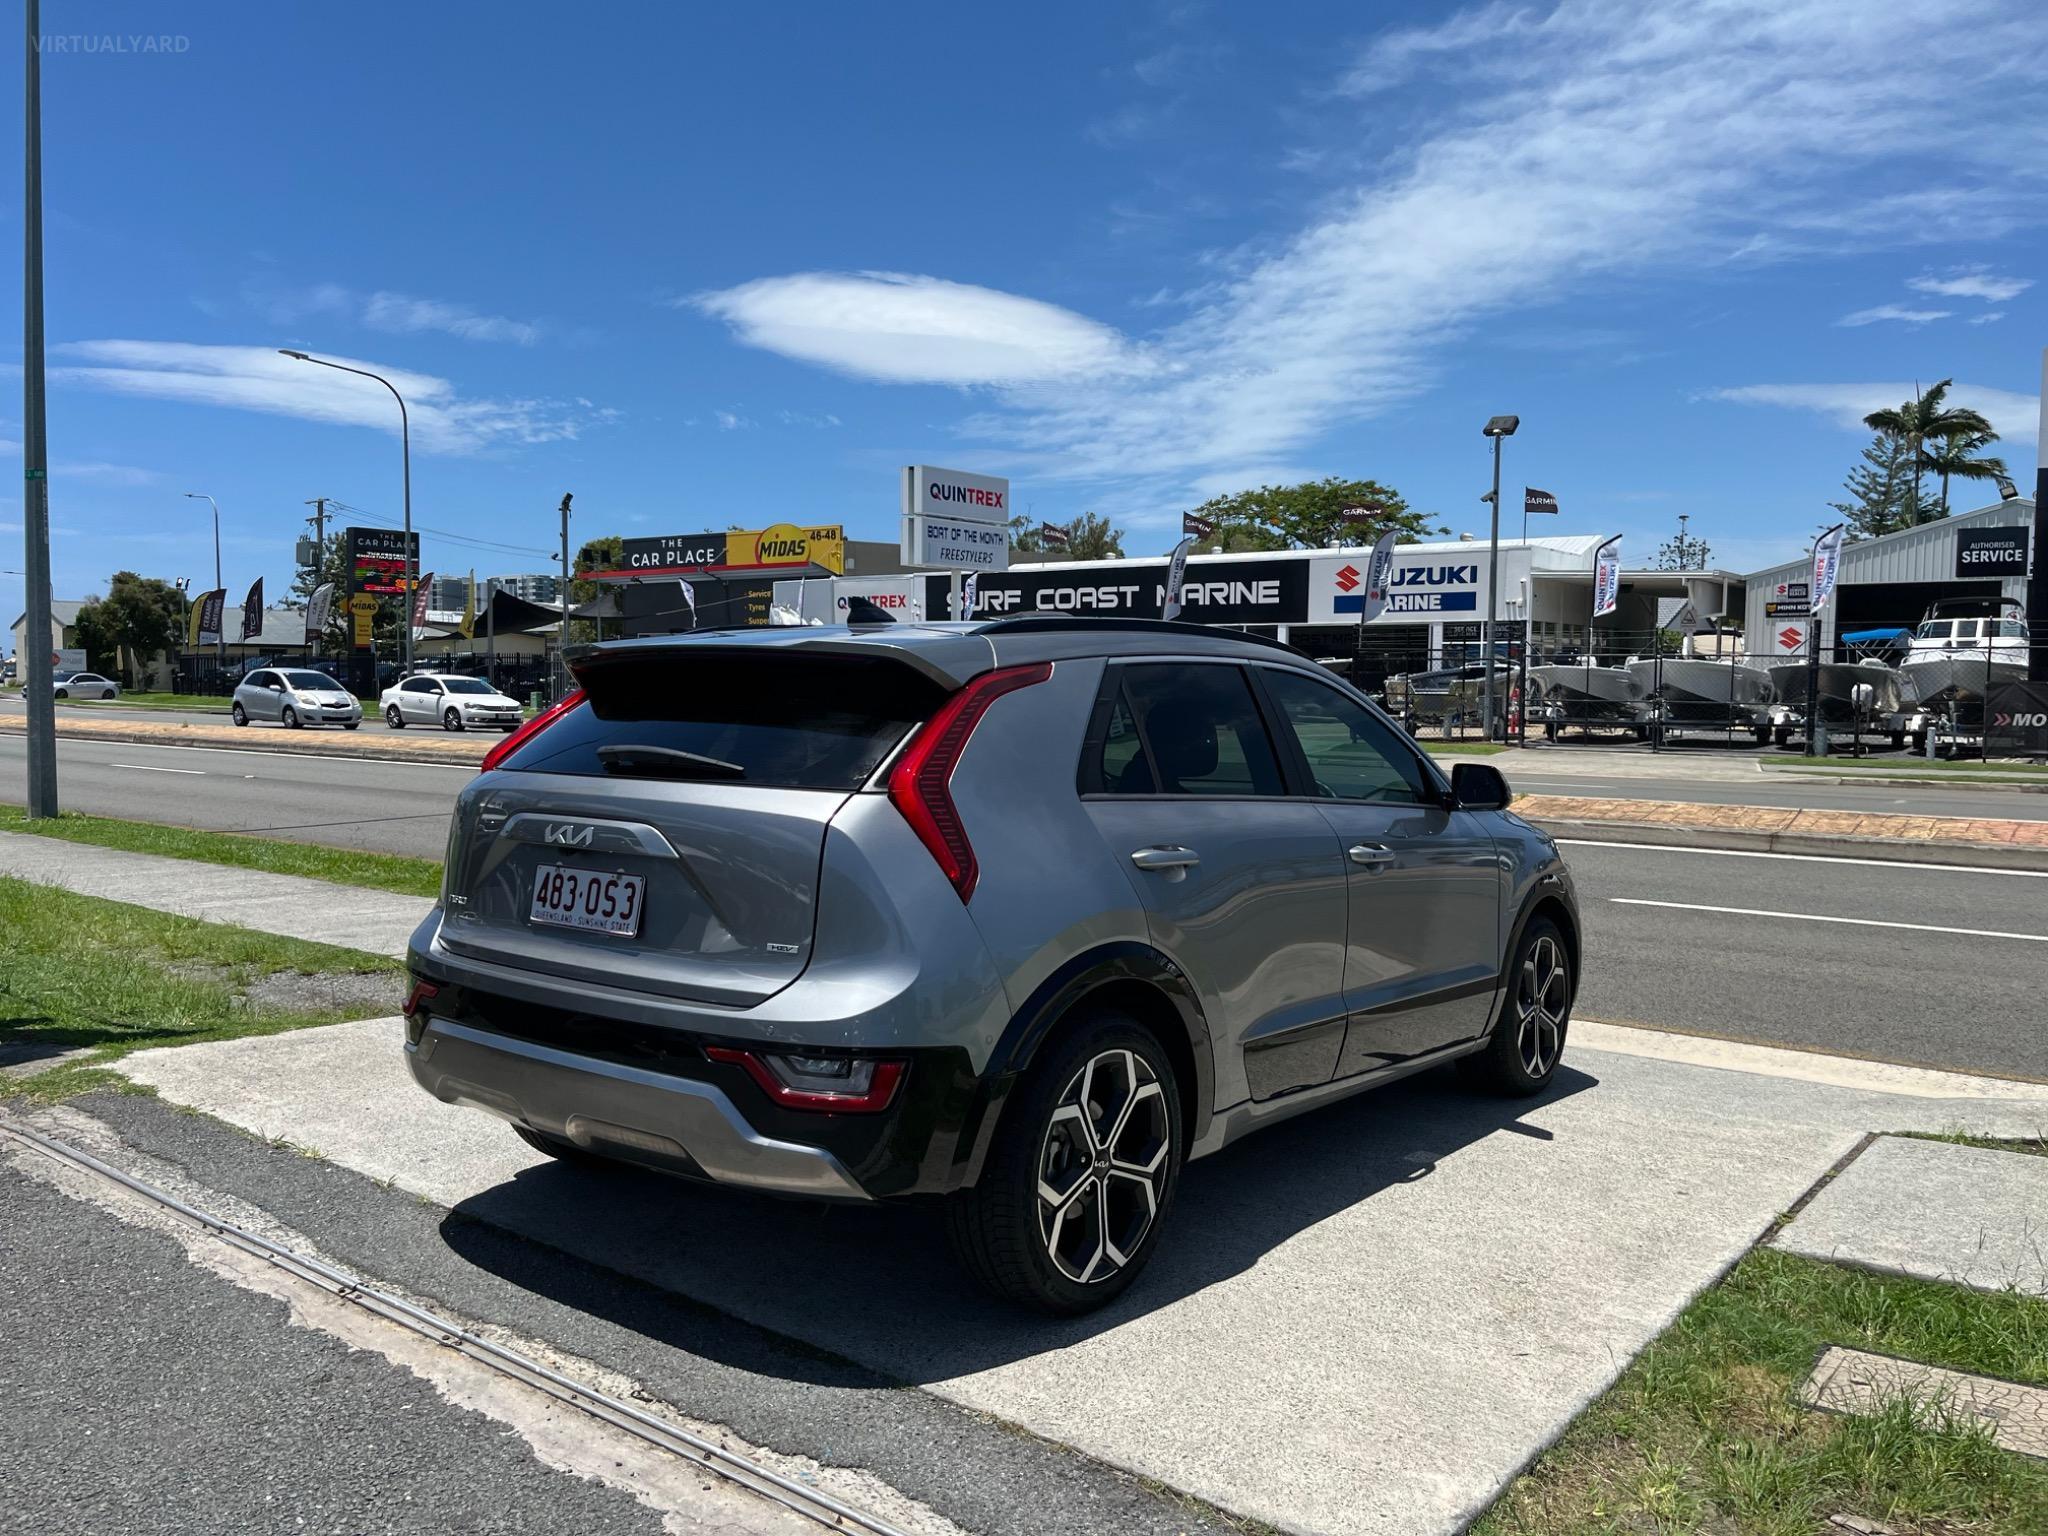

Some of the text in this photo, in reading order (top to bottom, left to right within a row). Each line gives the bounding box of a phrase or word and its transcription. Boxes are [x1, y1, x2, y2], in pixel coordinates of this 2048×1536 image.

[930, 483, 1003, 508] QUINTREX
[661, 538, 683, 548] THE
[809, 529, 837, 541] 46-48
[928, 525, 1004, 546] BOAT OF THE MONTH
[357, 537, 417, 550] CAR PLAE
[759, 539, 806, 559] MIDAS
[1970, 541, 2015, 550] AUTHORISED
[631, 548, 715, 567] CAR PLACE
[940, 547, 993, 564] FREESTYLERS
[1961, 549, 2023, 564] SERVICE
[1390, 565, 1478, 587] UZUKI
[1036, 585, 1140, 610] COAST
[1384, 594, 1441, 611] ARINE
[350, 601, 377, 611] MIDAS
[2012, 713, 2047, 727] MO
[611, 921, 630, 932] STATE
